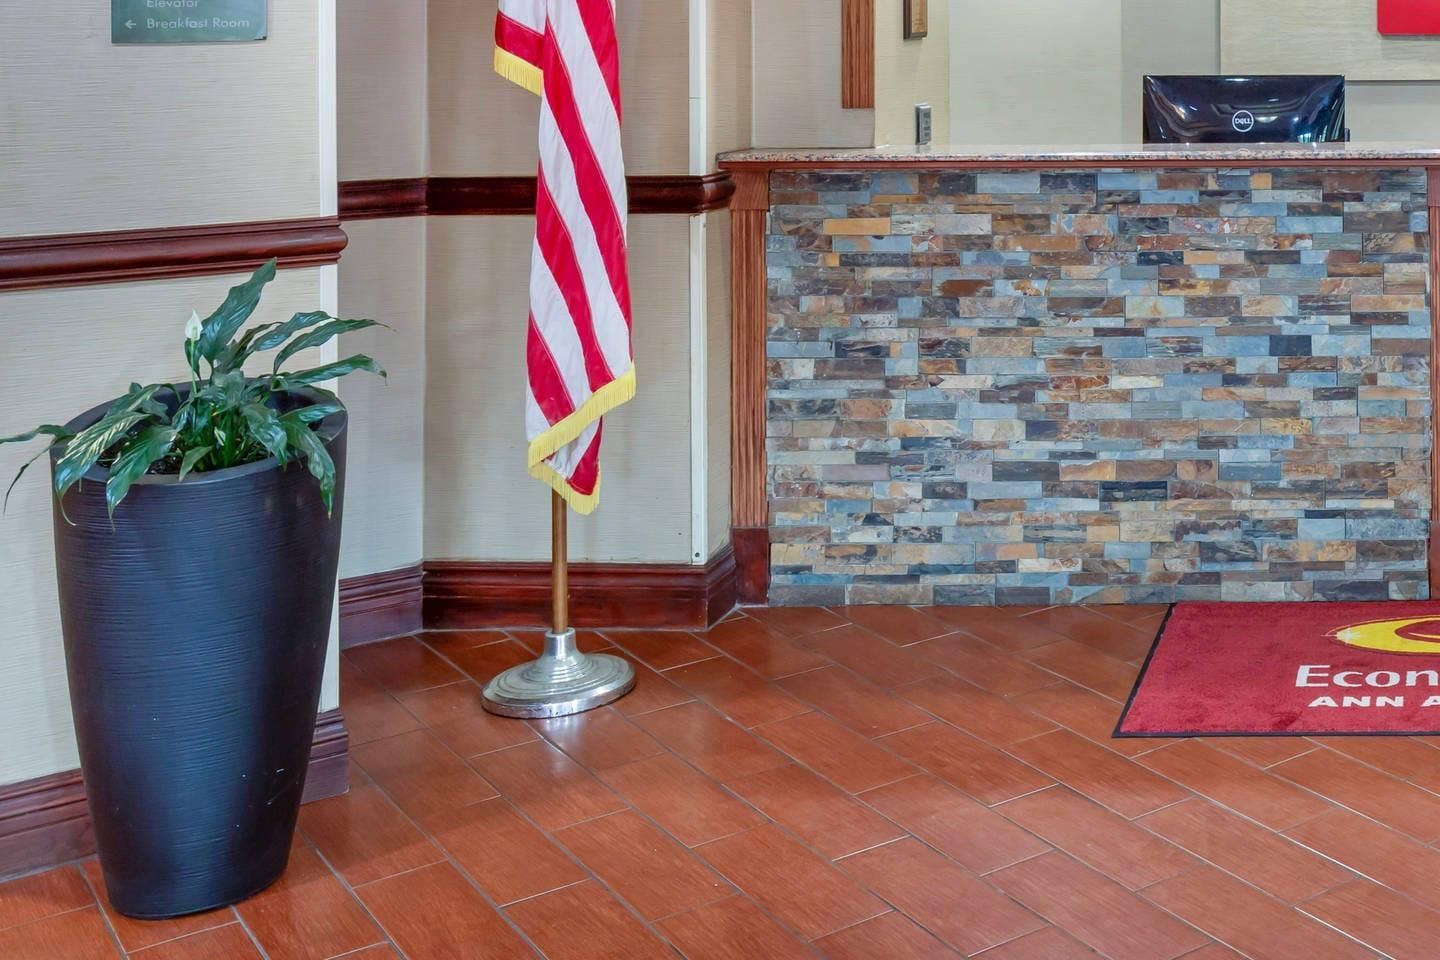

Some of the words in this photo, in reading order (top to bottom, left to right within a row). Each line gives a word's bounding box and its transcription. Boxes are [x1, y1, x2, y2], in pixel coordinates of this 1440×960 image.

[146, 17, 209, 29] Breakfast
[213, 17, 250, 28] Room
[1308, 695, 1404, 708] ANN
